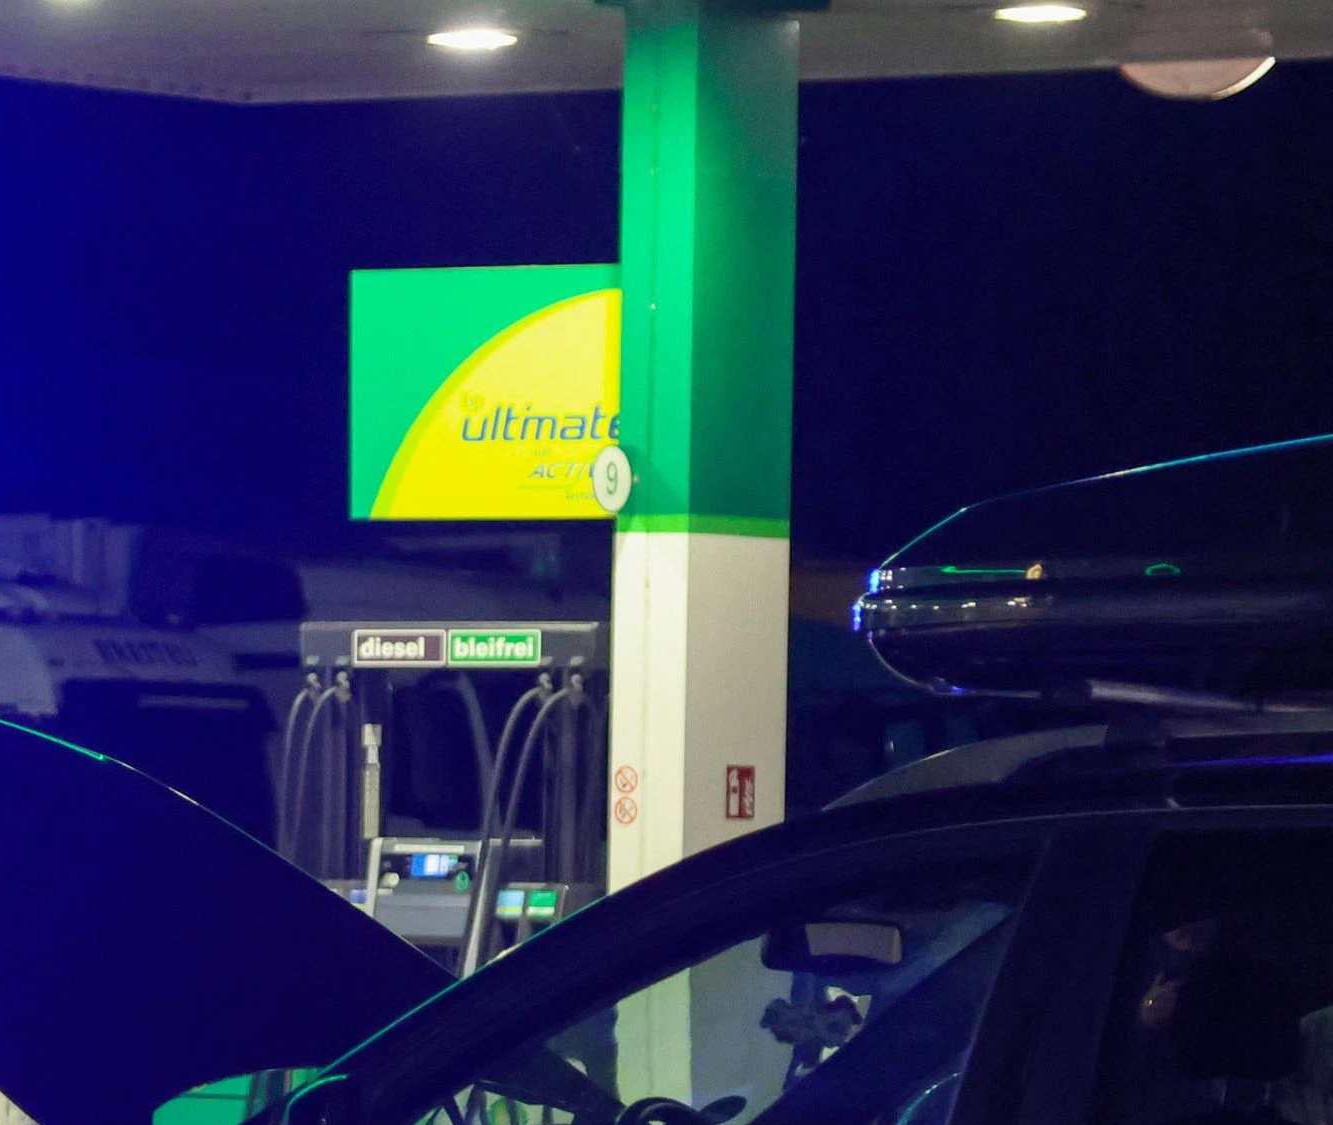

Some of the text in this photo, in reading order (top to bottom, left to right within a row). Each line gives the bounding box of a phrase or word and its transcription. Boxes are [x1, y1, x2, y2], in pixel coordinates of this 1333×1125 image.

[605, 461, 619, 495] 9
[358, 636, 425, 660] diesel
[454, 636, 534, 660] bleifrei
